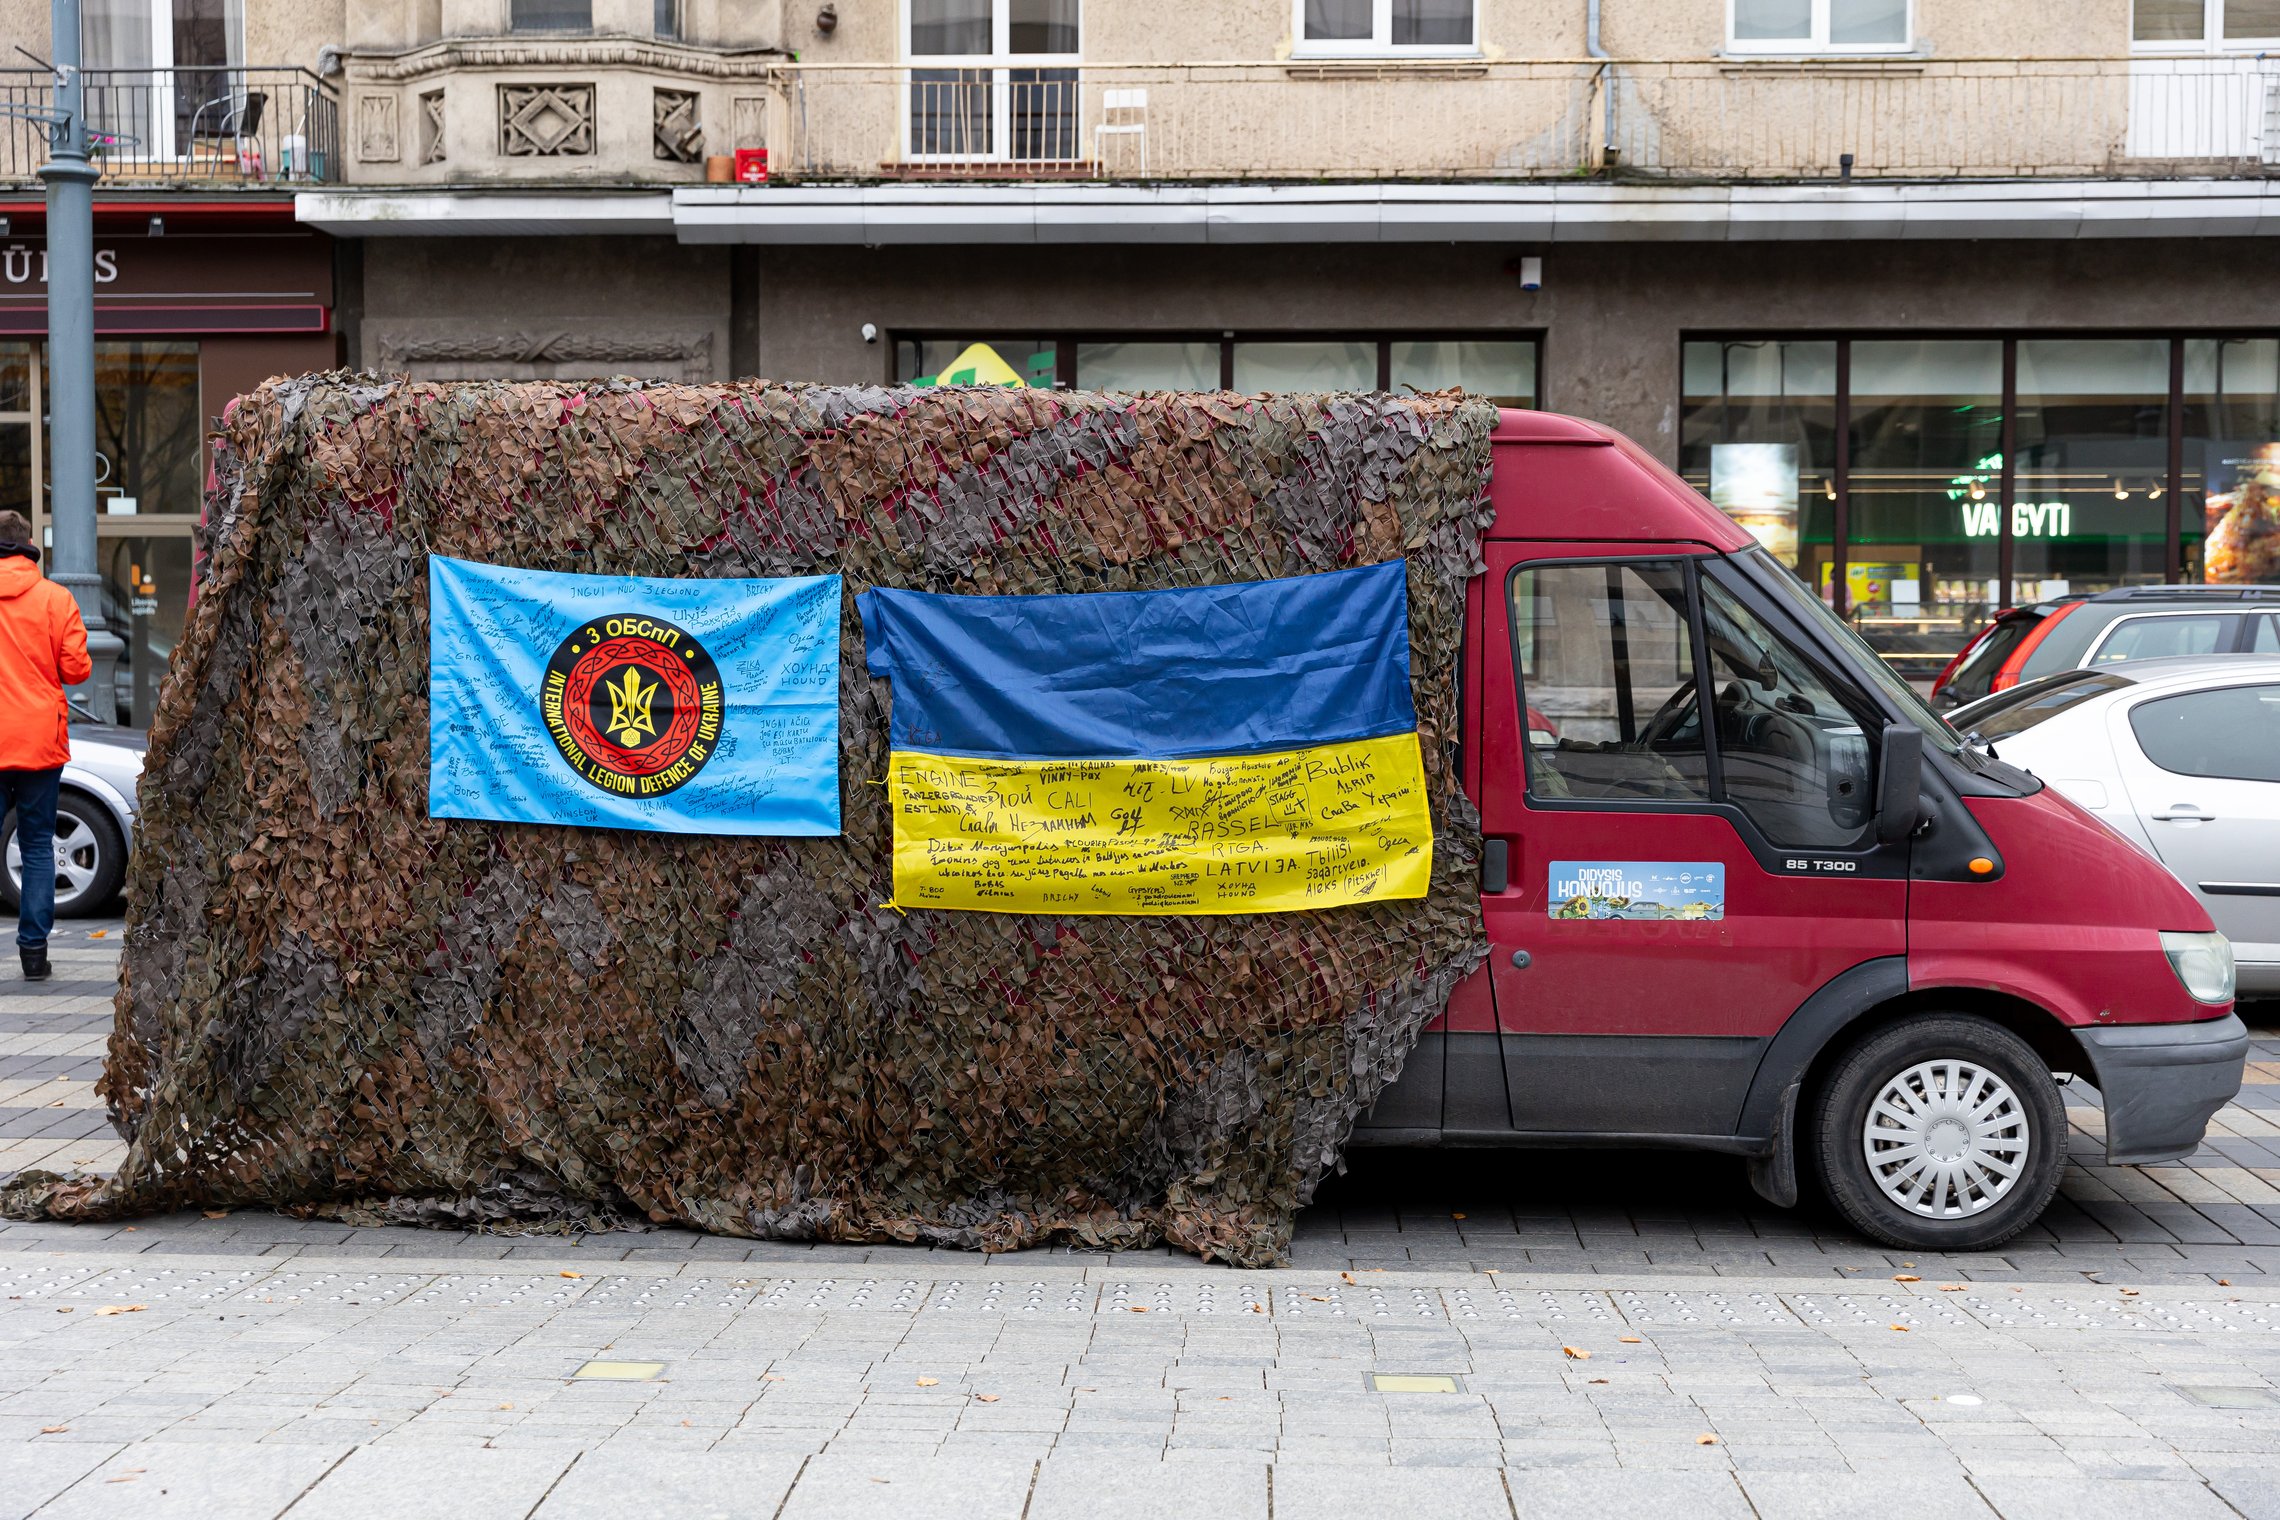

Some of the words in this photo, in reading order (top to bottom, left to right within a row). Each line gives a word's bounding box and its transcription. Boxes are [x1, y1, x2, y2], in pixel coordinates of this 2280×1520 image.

[1962, 502, 2070, 537] VAGYTI
[780, 662, 831, 676] ХОУНД
[781, 676, 828, 687] HOUND
[473, 714, 510, 742] SWEDE
[544, 669, 589, 772] INTERNATIONAL
[587, 763, 636, 794] LEGION
[640, 757, 696, 794] DEFENCE
[688, 742, 708, 762] OF
[698, 681, 720, 742] UKRAINE
[1080, 761, 1116, 771] KAUNAS
[1306, 753, 1372, 782] Bublik
[536, 771, 579, 789] RANDY
[900, 765, 980, 788] ENGINE
[1171, 775, 1198, 794] LV
[1047, 791, 1092, 810] CALI
[1268, 789, 1298, 806] STAGG
[904, 803, 961, 819] ESTLAND
[1786, 859, 1808, 870] 85
[1813, 860, 1856, 872] T300
[1578, 868, 1623, 882] DIDYSIS
[1217, 890, 1256, 899] HOUND
[1558, 880, 1643, 898] KONVOJUS
